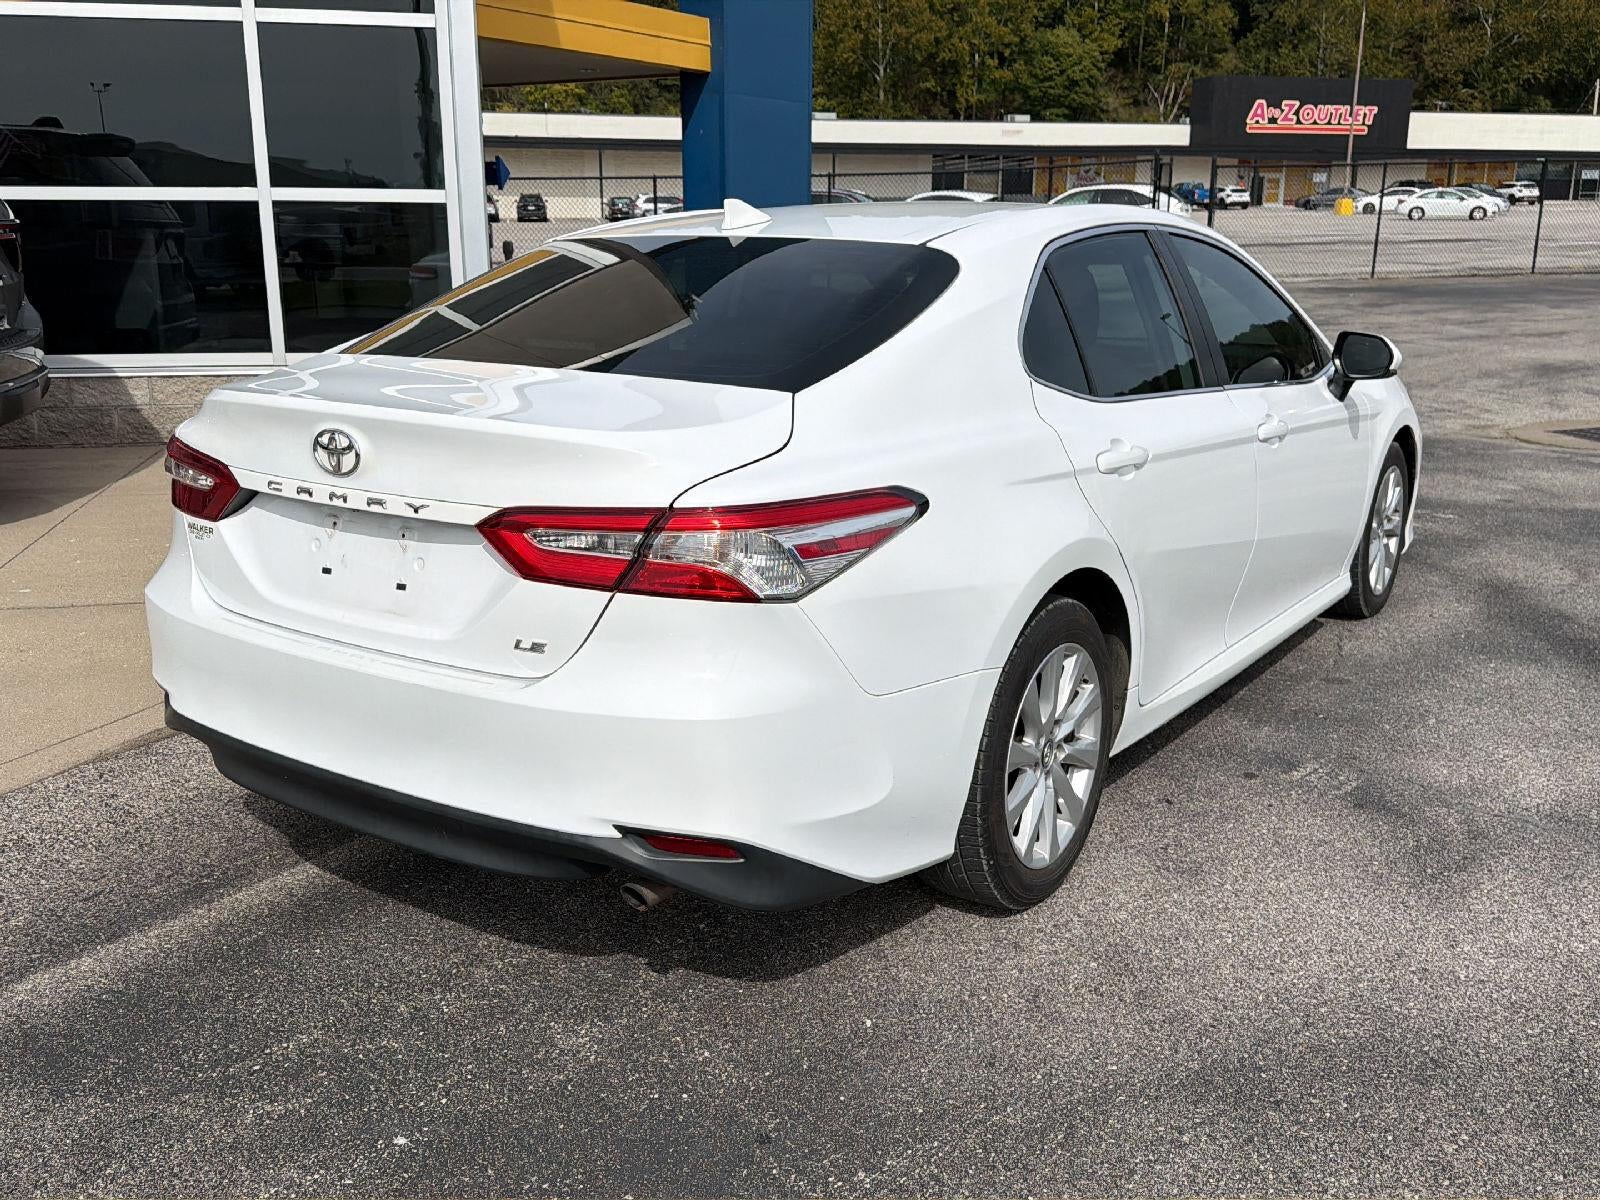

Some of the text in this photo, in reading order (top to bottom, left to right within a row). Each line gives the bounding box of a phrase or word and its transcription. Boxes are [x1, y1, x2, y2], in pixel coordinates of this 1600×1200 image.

[1246, 99, 1268, 123] A
[1278, 100, 1300, 124] Z
[1300, 104, 1378, 125] OUTLET
[267, 480, 430, 514] CAMRY
[187, 521, 213, 534] WALKER
[514, 639, 547, 654] LE
